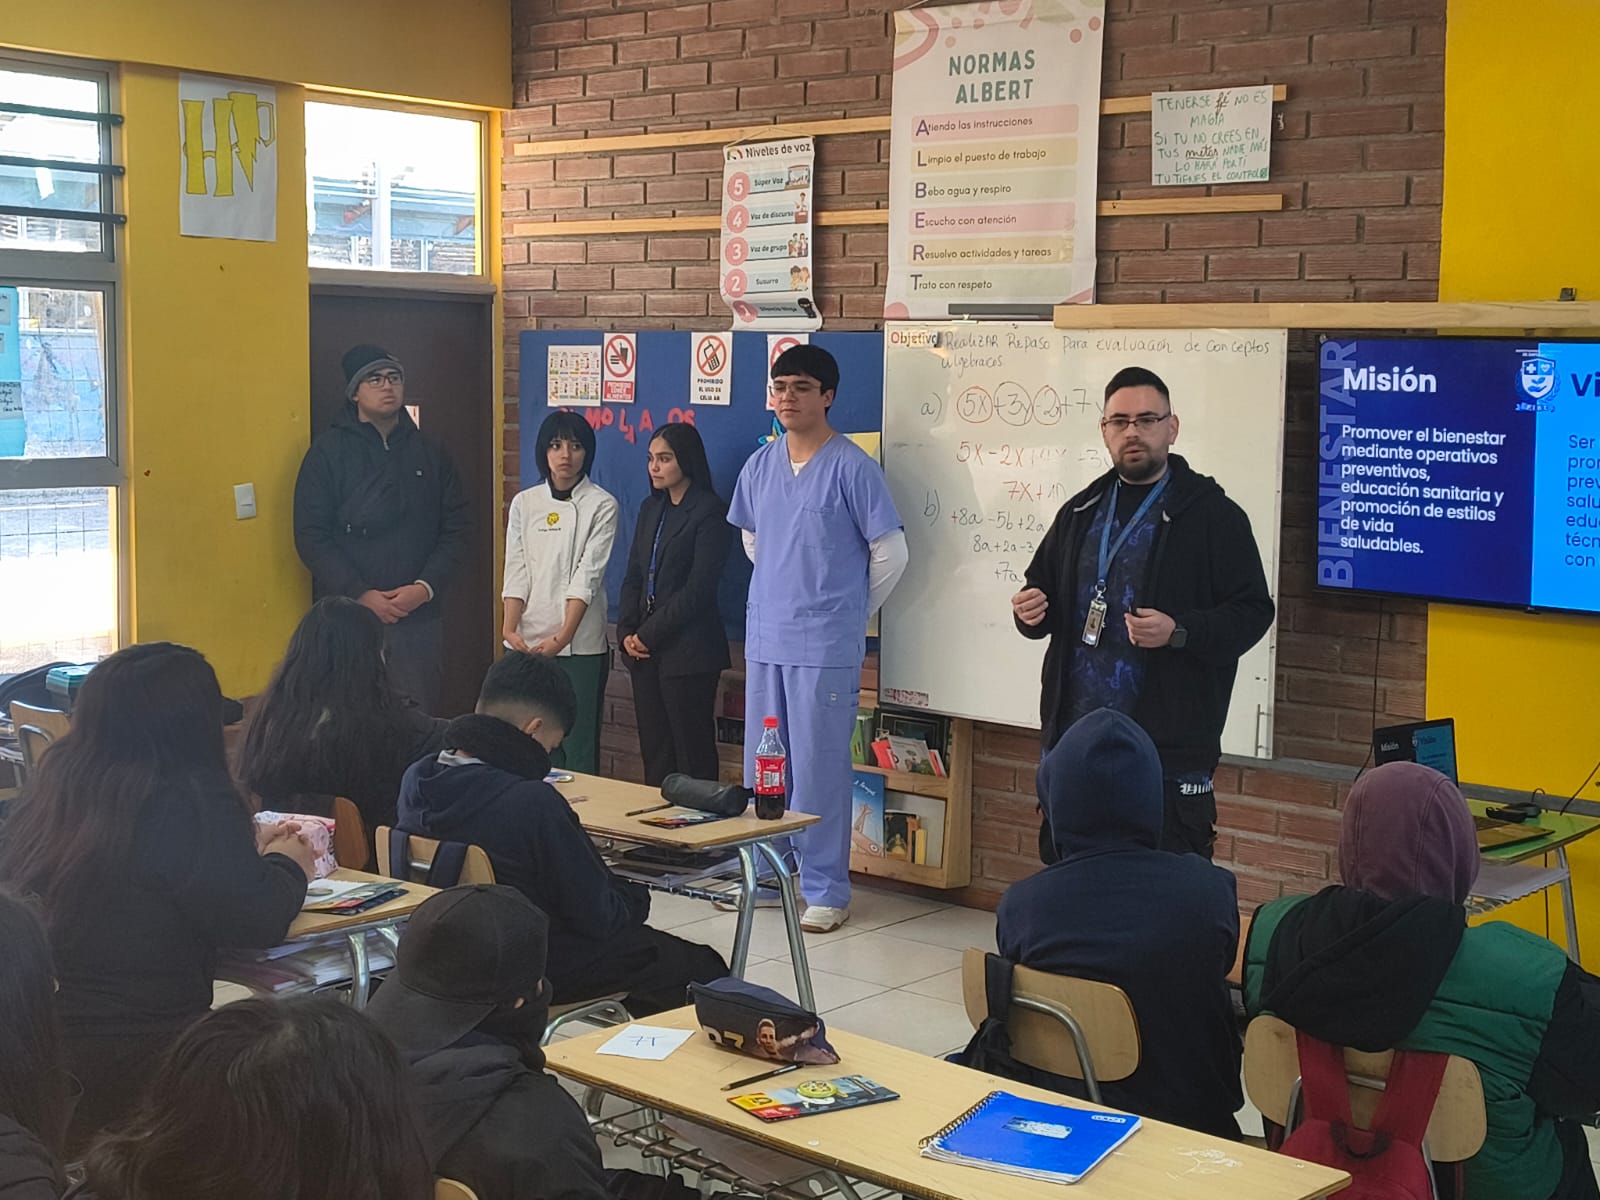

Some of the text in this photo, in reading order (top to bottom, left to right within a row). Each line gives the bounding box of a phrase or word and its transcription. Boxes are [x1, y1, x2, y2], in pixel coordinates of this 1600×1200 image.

[948, 49, 1036, 76] NORMAS
[955, 78, 1034, 104] ALBERT
[1157, 95, 1211, 112] TENERSE
[1234, 93, 1249, 106] NO
[1253, 90, 1268, 105] ES
[915, 117, 1033, 137] Atiendo las instrucciones
[1174, 132, 1188, 144] TU
[1193, 132, 1207, 144] NO
[1212, 129, 1242, 144] CREES
[1245, 127, 1260, 139] EN
[745, 143, 811, 158] Niveles de voz
[917, 148, 1047, 167] Limpio el puesto de trabajo
[1157, 149, 1179, 159] TUS
[1175, 162, 1190, 173] LO
[733, 178, 743, 196] 5
[1155, 173, 1171, 184] TU
[1212, 172, 1222, 180] EL
[915, 181, 1012, 199] Bebo agua y respiro
[732, 210, 743, 228] 4
[770, 210, 794, 218] discurso
[915, 212, 1017, 229] Escucho con atención
[732, 243, 742, 260] 3
[770, 244, 788, 253] grupo
[913, 244, 1052, 261] Resuelvo actividades y tareas
[731, 275, 741, 292] 2
[910, 273, 993, 291] Trato con respeto
[1184, 331, 1201, 352] de
[1342, 365, 1437, 393] Misión
[1341, 424, 1507, 446] Promover el bienestar
[1568, 434, 1596, 449] Ser
[1341, 443, 1498, 465] mediante operativos
[1318, 340, 1357, 588] BIENESTAR
[1341, 462, 1431, 482] preventivos,
[1341, 480, 1504, 507] educación sanitaria y
[1341, 499, 1496, 522] promoción de estilos
[1341, 516, 1394, 533] de vida
[1340, 534, 1424, 554] saludables.
[1564, 554, 1596, 567] con
